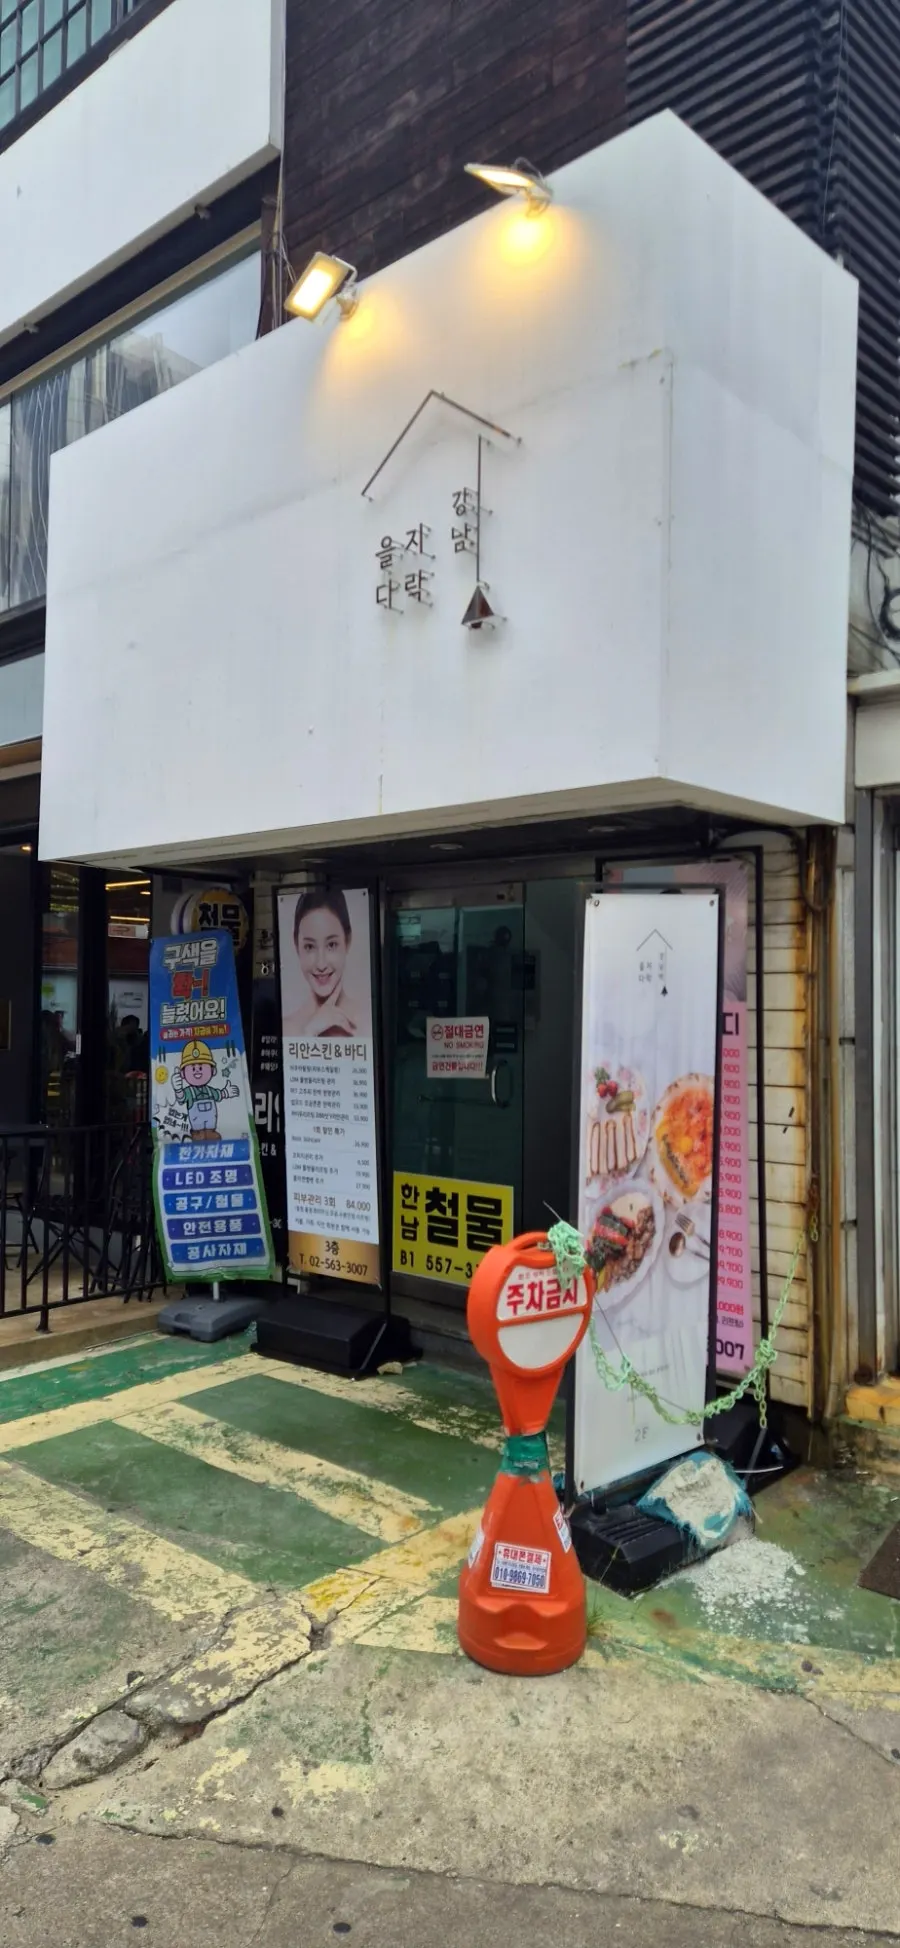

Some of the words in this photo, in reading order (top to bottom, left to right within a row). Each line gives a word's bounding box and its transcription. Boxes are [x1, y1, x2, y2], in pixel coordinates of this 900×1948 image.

[452, 487, 470, 553] 강남
[164, 940, 217, 970] 구색을
[162, 999, 226, 1025] 늘렸어요!
[444, 1023, 484, 1039] 절대금연
[288, 1043, 332, 1060] 리안스킨
[334, 1044, 342, 1058] &
[344, 1044, 367, 1061] 바디
[456, 1041, 485, 1049] SMOKING
[178, 1143, 235, 1161] 전기자재
[175, 1171, 205, 1186] LED
[209, 1169, 238, 1185] 조명
[293, 1192, 322, 1207] 피부관리
[324, 1196, 336, 1208] 3회
[400, 1183, 420, 1242] 한남
[425, 1187, 503, 1254] 철물
[183, 1218, 243, 1236] 안전용품
[187, 1242, 248, 1260] 공사자재
[325, 1240, 340, 1255] 3층
[309, 1255, 368, 1277] 02-563-3007
[400, 1249, 415, 1268] B1
[426, 1254, 480, 1279] 557-3
[506, 1278, 578, 1316] 주차금지
